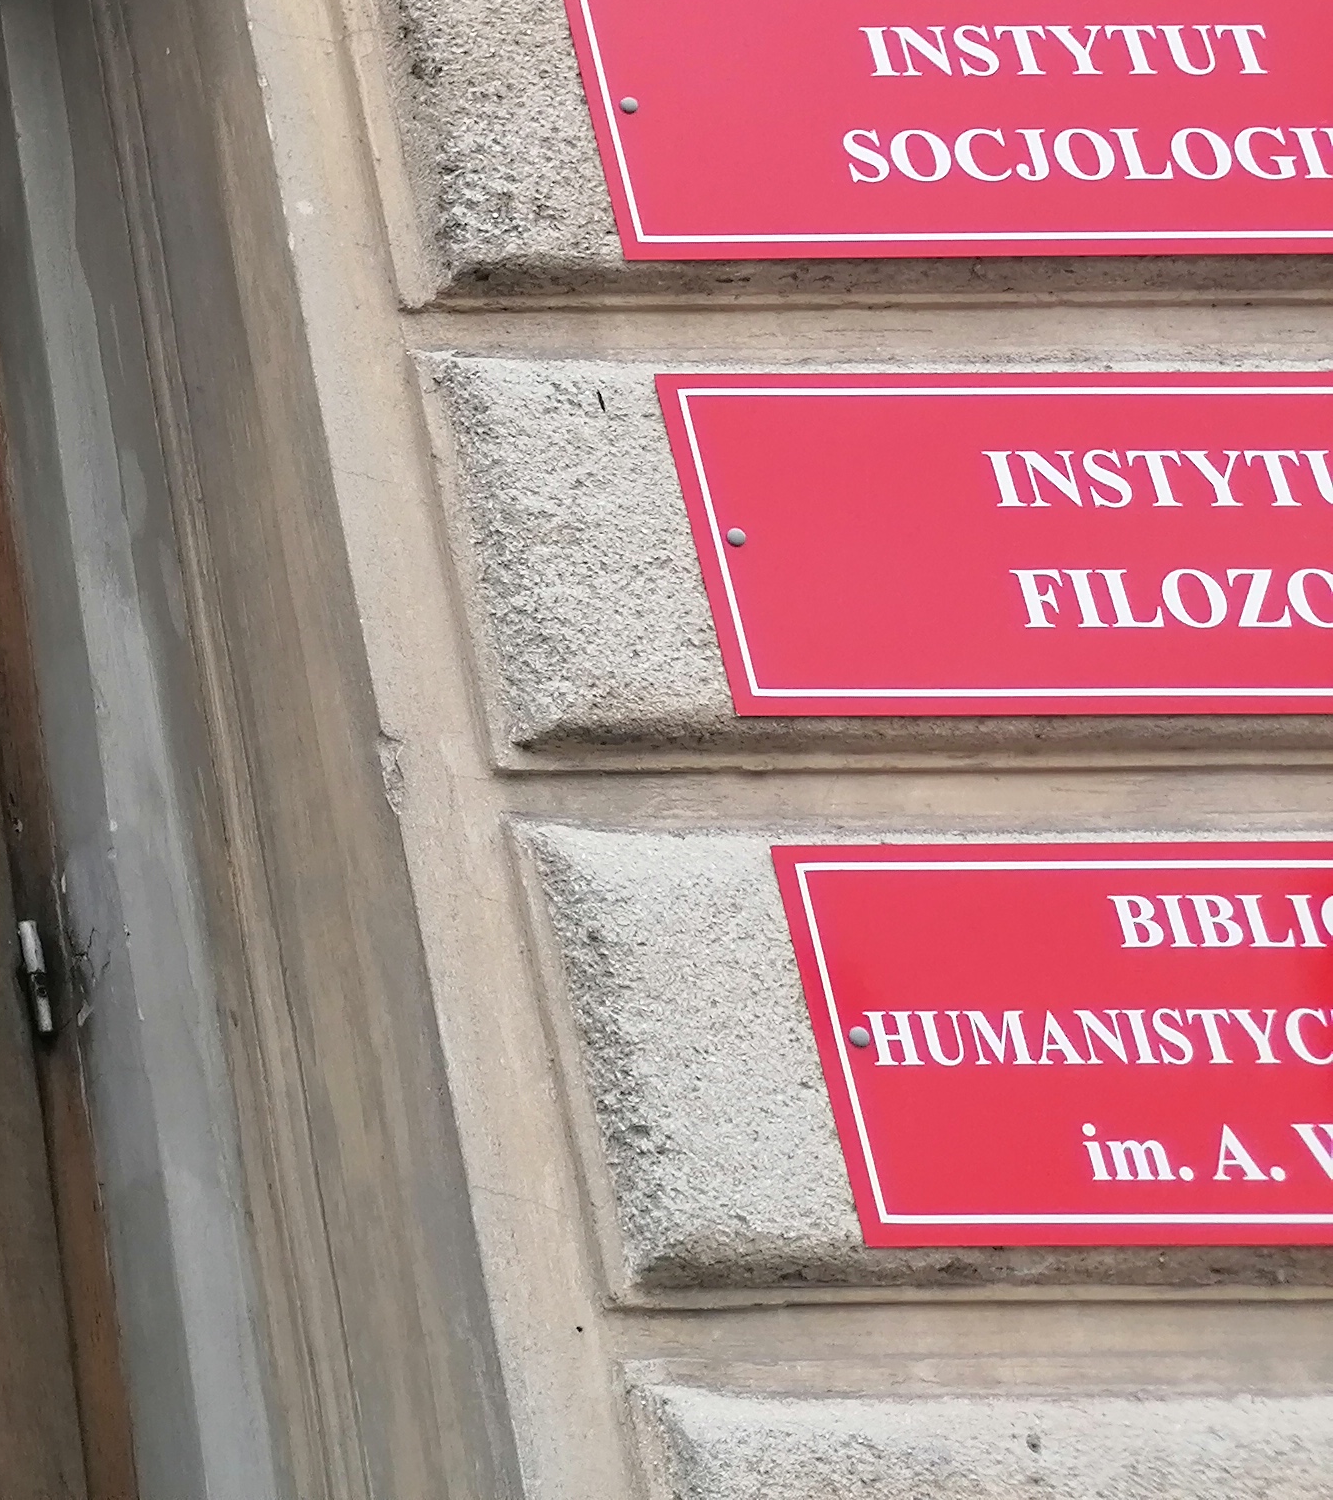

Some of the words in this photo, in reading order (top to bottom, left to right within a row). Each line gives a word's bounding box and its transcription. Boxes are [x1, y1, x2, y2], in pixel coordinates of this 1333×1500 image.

[858, 24, 1268, 77] INSTYTUT
[842, 126, 1333, 183] SOCJOLOGI
[1106, 894, 1333, 948] BIBLI
[1082, 1123, 1194, 1182] im.
[1213, 1124, 1286, 1182] A.
